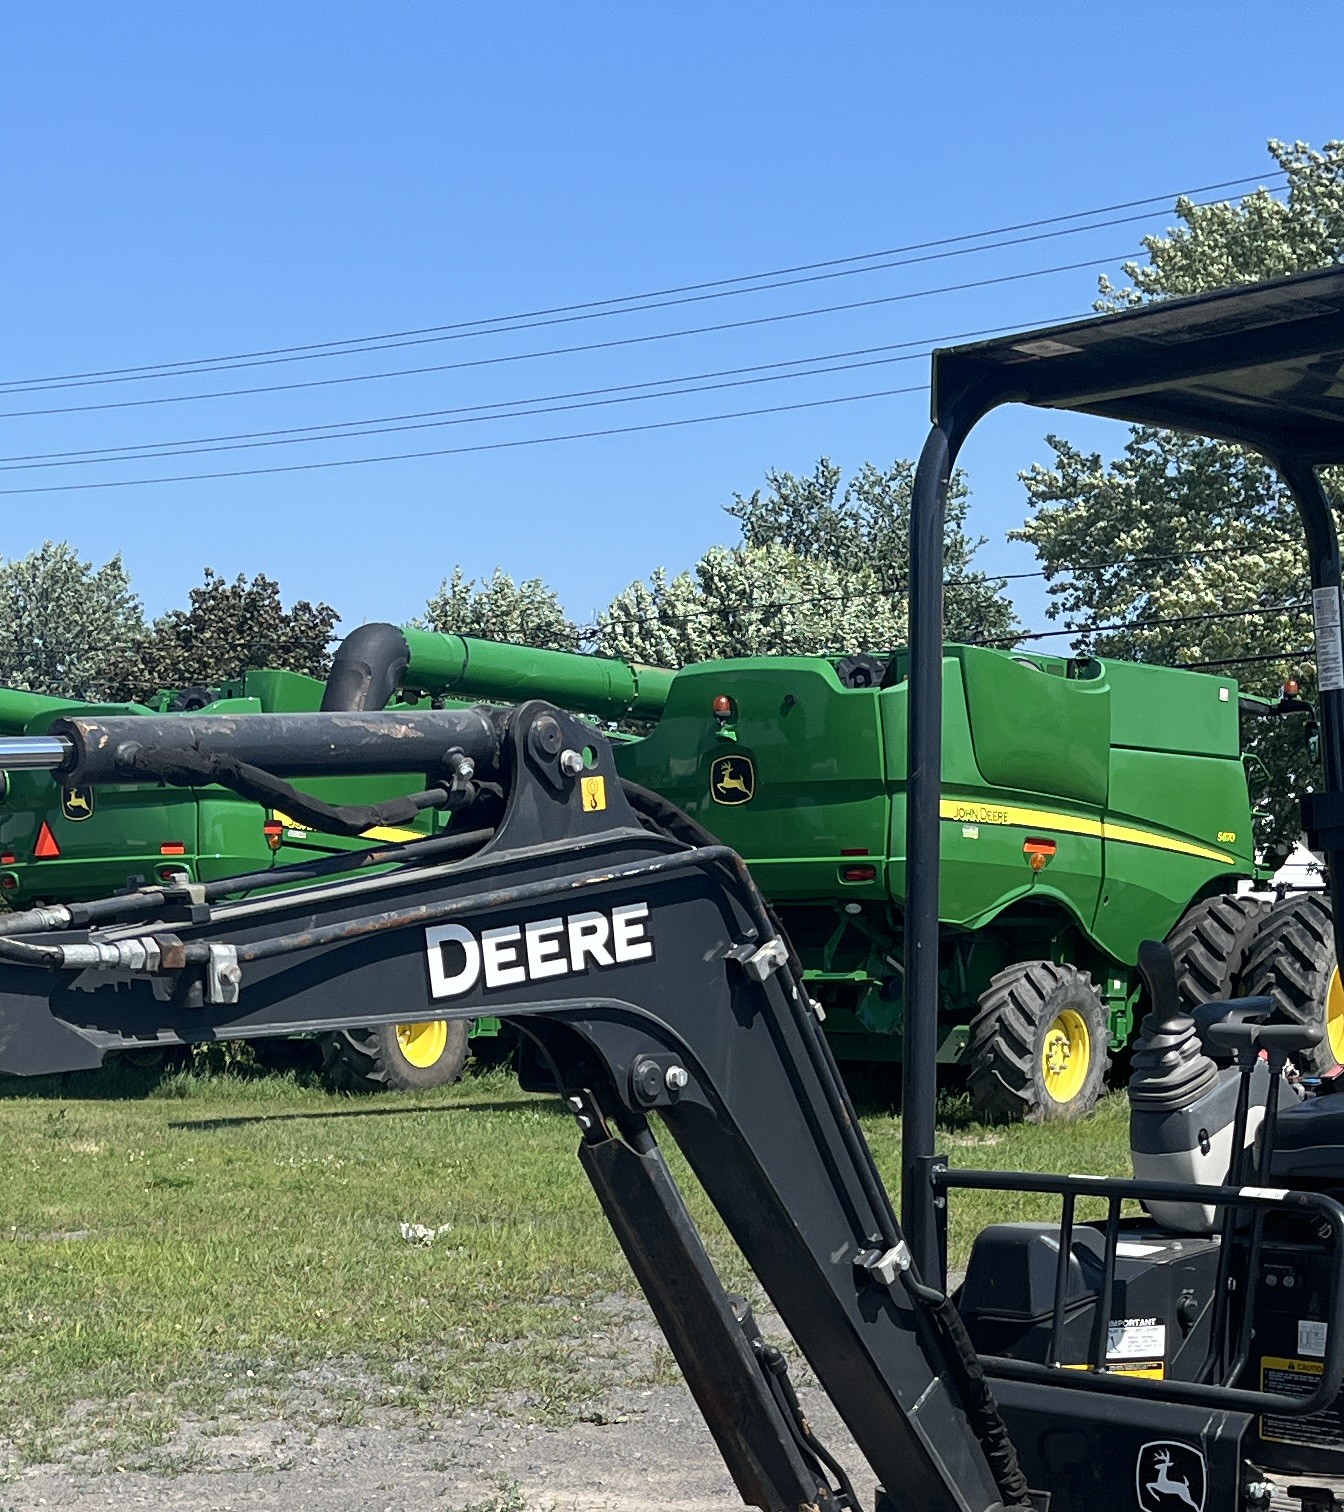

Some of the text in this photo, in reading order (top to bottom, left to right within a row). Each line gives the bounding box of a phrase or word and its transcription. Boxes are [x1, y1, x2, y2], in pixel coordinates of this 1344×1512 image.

[953, 805, 1008, 823] JOHN DEERE
[424, 902, 654, 999] DEERE
[1297, 1362, 1324, 1373] CAUTIO
